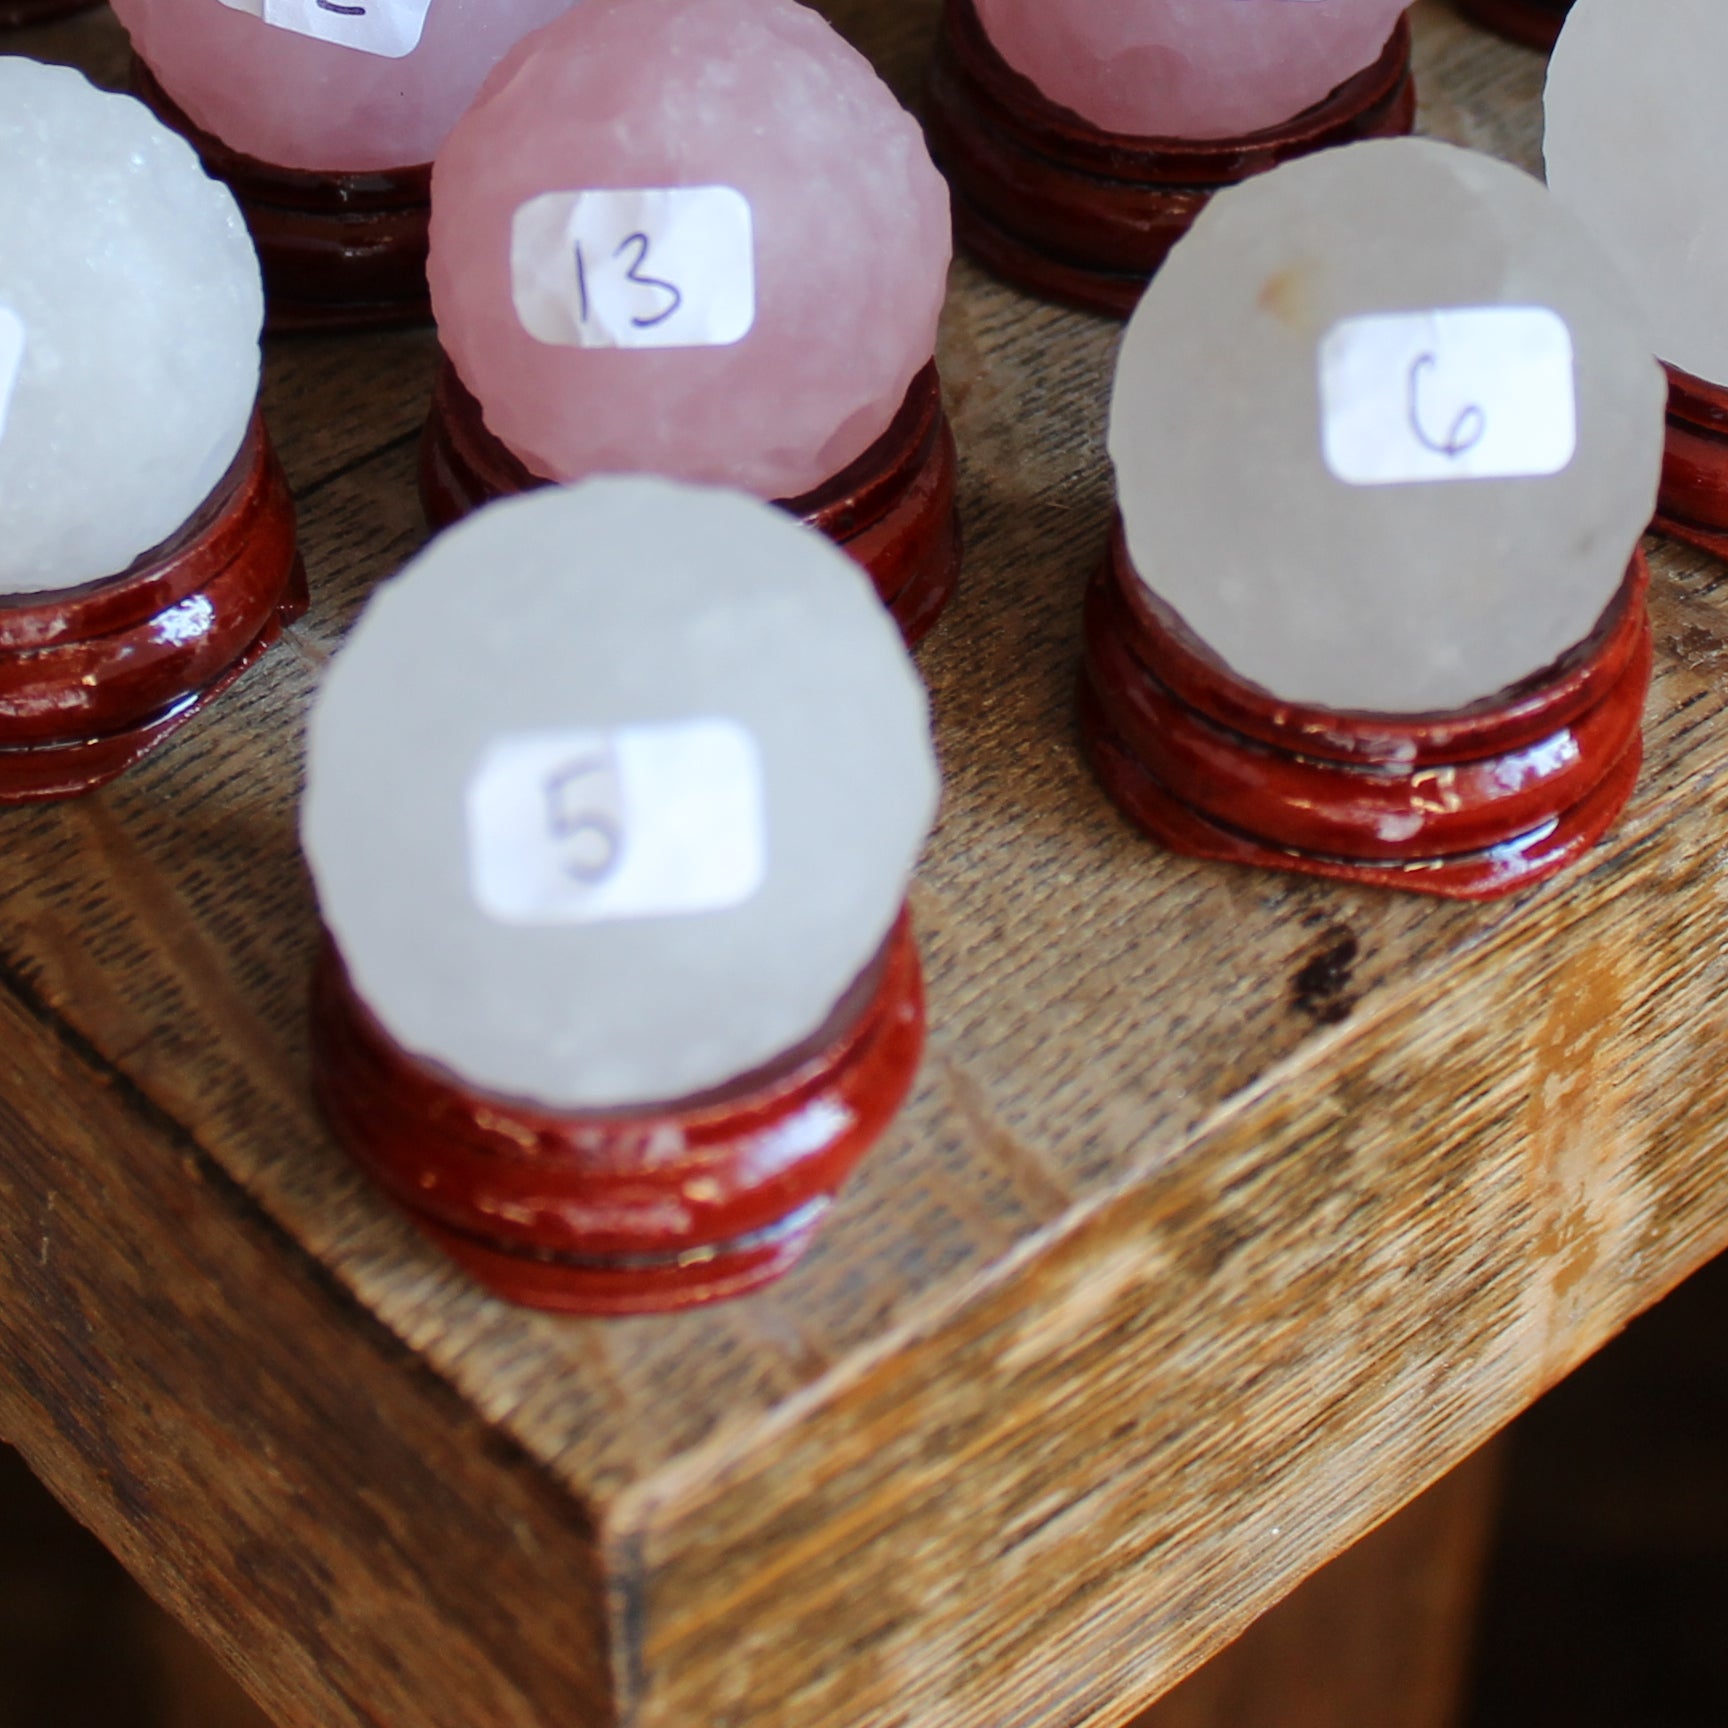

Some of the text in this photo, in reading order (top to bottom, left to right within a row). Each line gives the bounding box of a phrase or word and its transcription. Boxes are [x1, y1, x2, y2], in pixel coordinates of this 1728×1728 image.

[573, 231, 683, 329] 13
[1408, 349, 1487, 461] 6
[542, 750, 628, 889] 5
